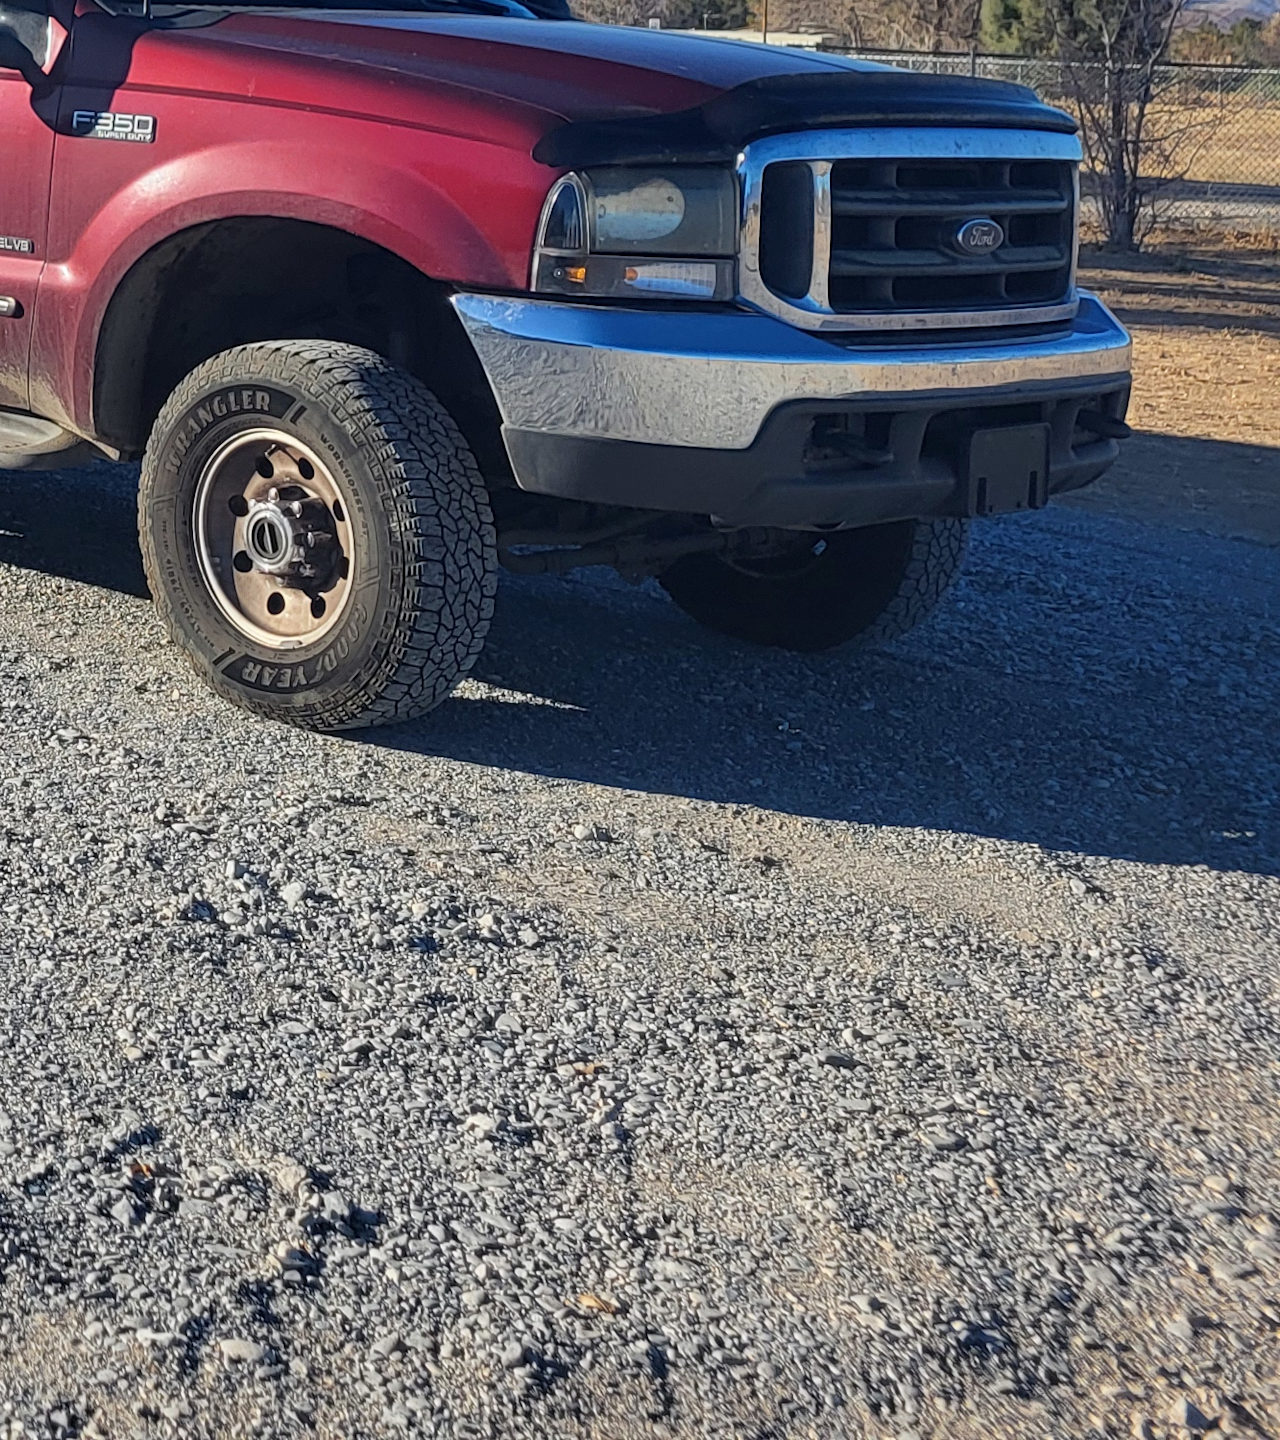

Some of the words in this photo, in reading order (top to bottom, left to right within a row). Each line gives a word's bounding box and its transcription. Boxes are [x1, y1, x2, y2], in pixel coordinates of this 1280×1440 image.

[970, 225, 995, 246] Ford
[164, 390, 271, 475] WRANGLER
[241, 603, 368, 689] GOODYEAR
